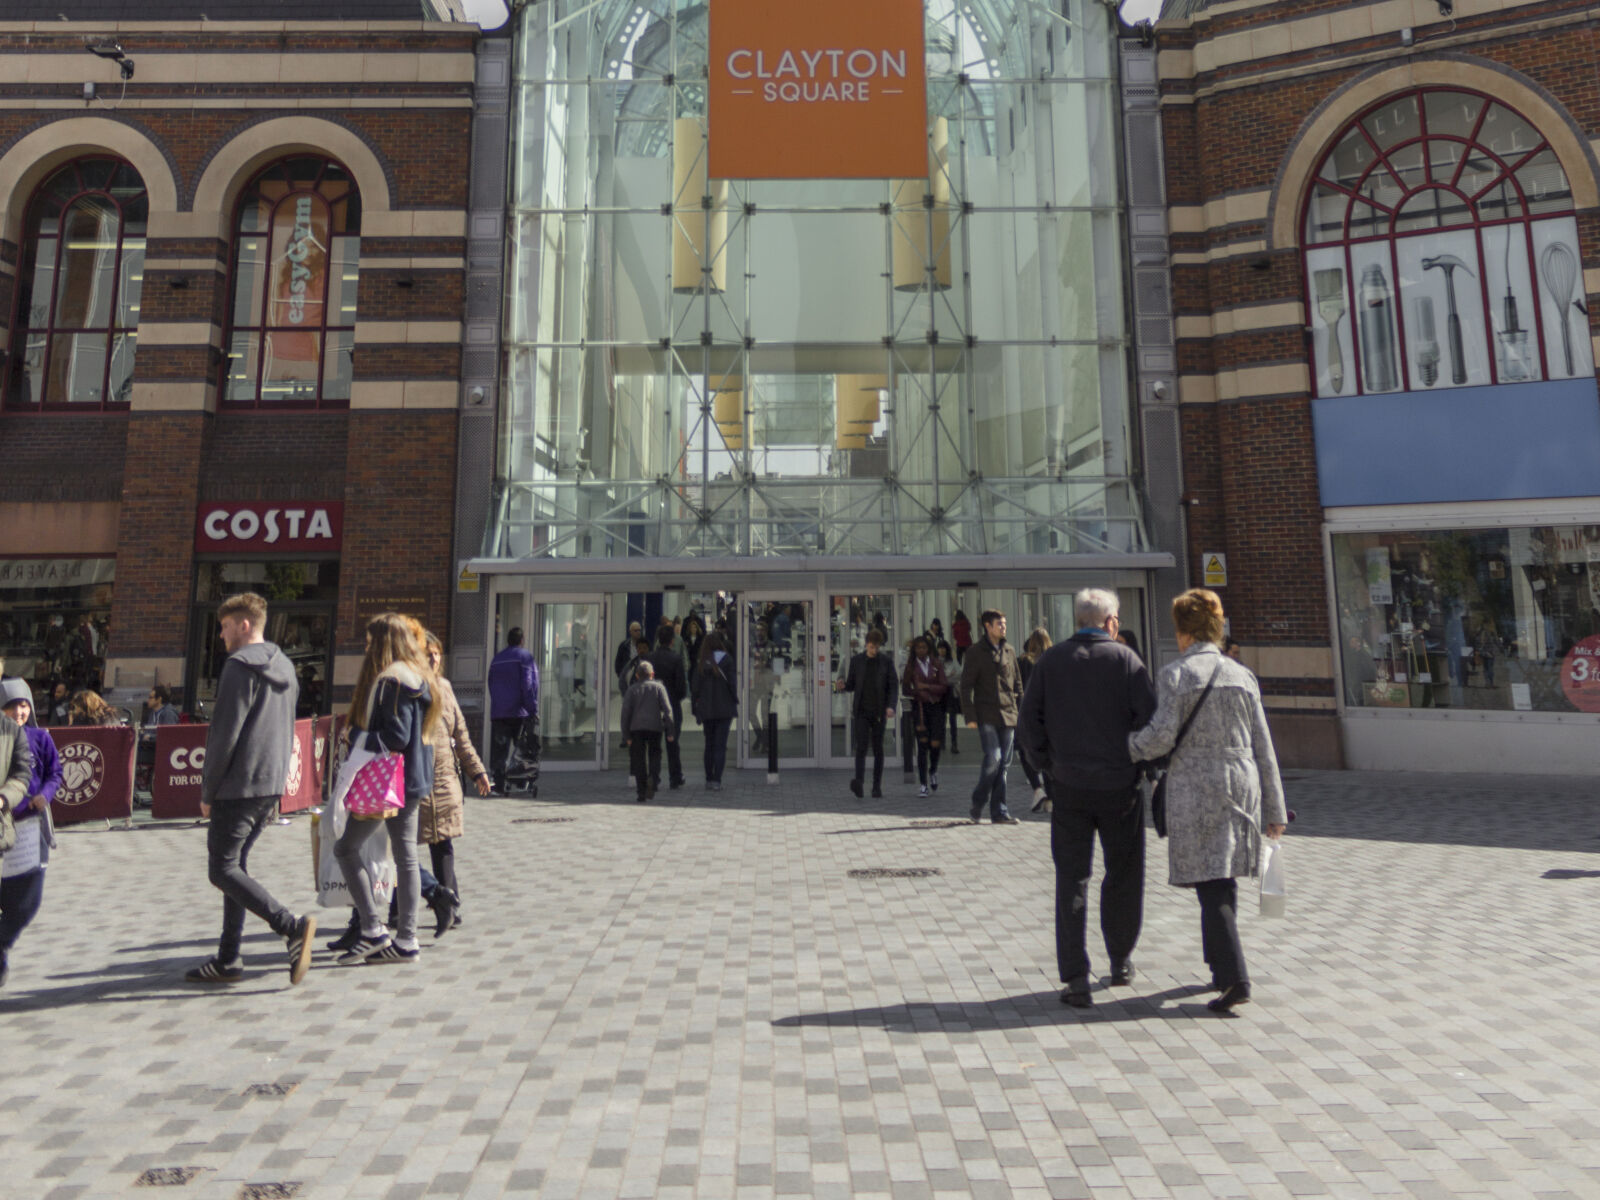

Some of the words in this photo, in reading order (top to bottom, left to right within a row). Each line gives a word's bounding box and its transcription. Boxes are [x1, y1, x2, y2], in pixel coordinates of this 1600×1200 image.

[727, 49, 906, 79] CLAYTON
[764, 82, 870, 102] SQUARE
[288, 197, 312, 324] easyGym
[204, 509, 333, 543] COSTA
[1574, 646, 1593, 656] Mix
[1570, 657, 1589, 681] 3
[55, 779, 100, 803] OFFEE
[169, 775, 188, 786] FOR
